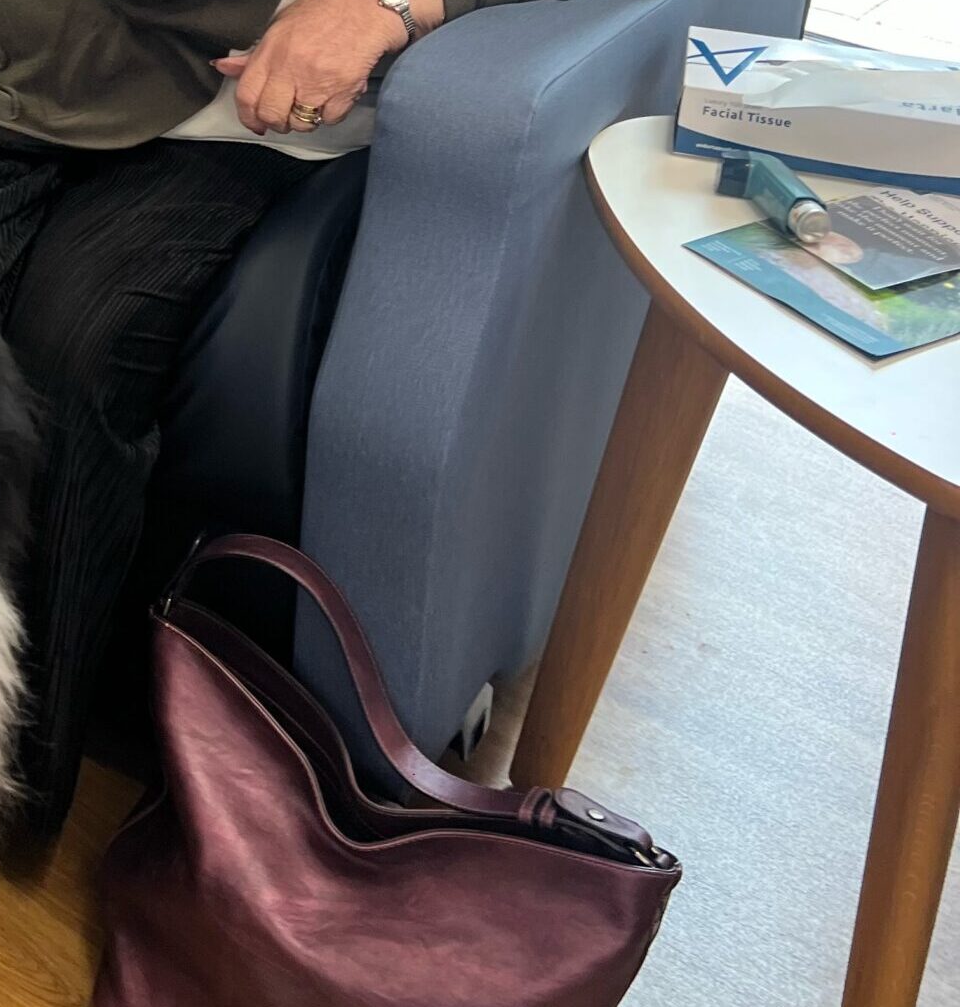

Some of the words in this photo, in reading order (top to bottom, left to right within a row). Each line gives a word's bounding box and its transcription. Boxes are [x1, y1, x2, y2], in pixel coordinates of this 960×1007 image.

[702, 105, 743, 121] Facial
[747, 112, 792, 128] Tissue
[880, 190, 916, 208] Help
